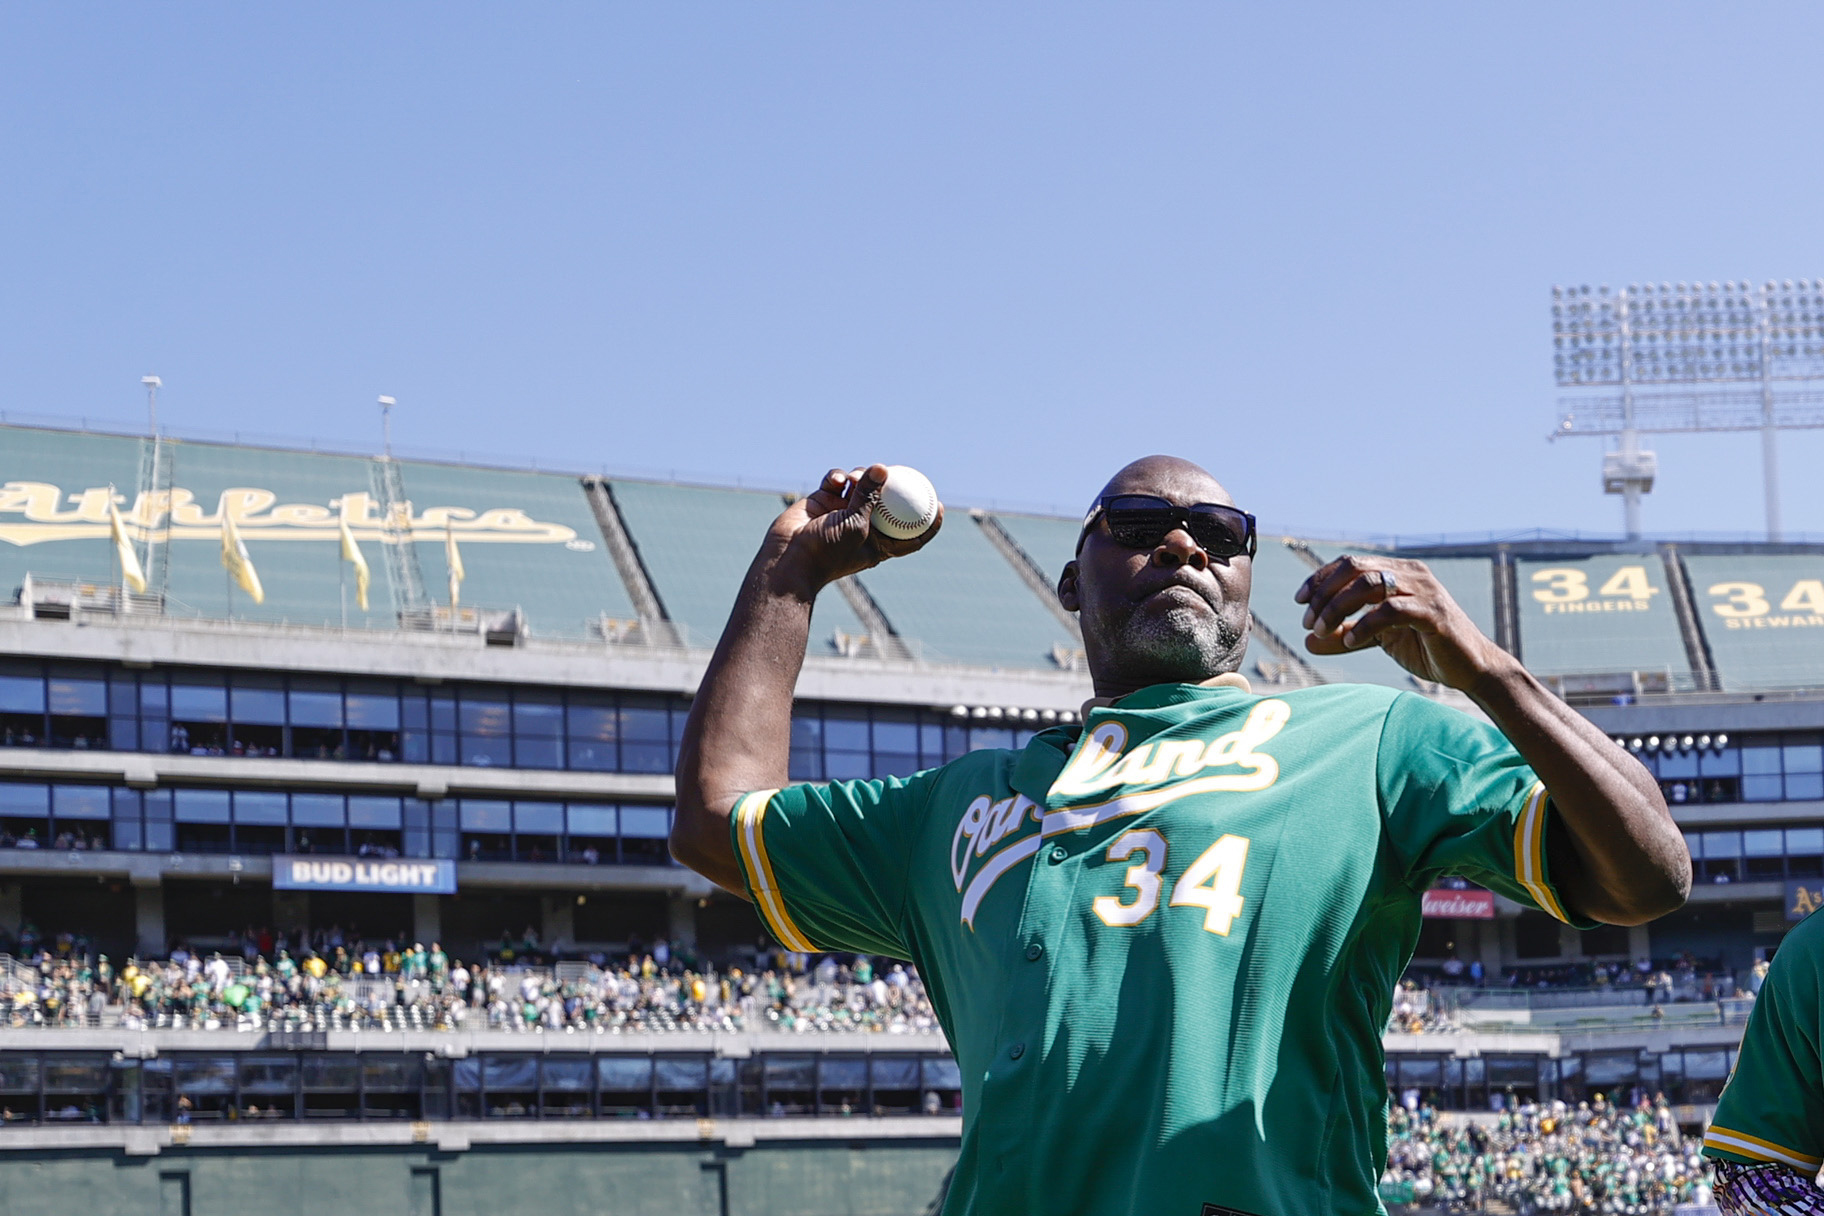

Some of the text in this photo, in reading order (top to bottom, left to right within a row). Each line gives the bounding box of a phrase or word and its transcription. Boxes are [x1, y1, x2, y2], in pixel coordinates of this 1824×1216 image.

[1531, 566, 1660, 603] 34
[1544, 600, 1650, 614] FINGERS
[292, 861, 437, 887] BUD LIGHT
[1092, 826, 1250, 937] 34
